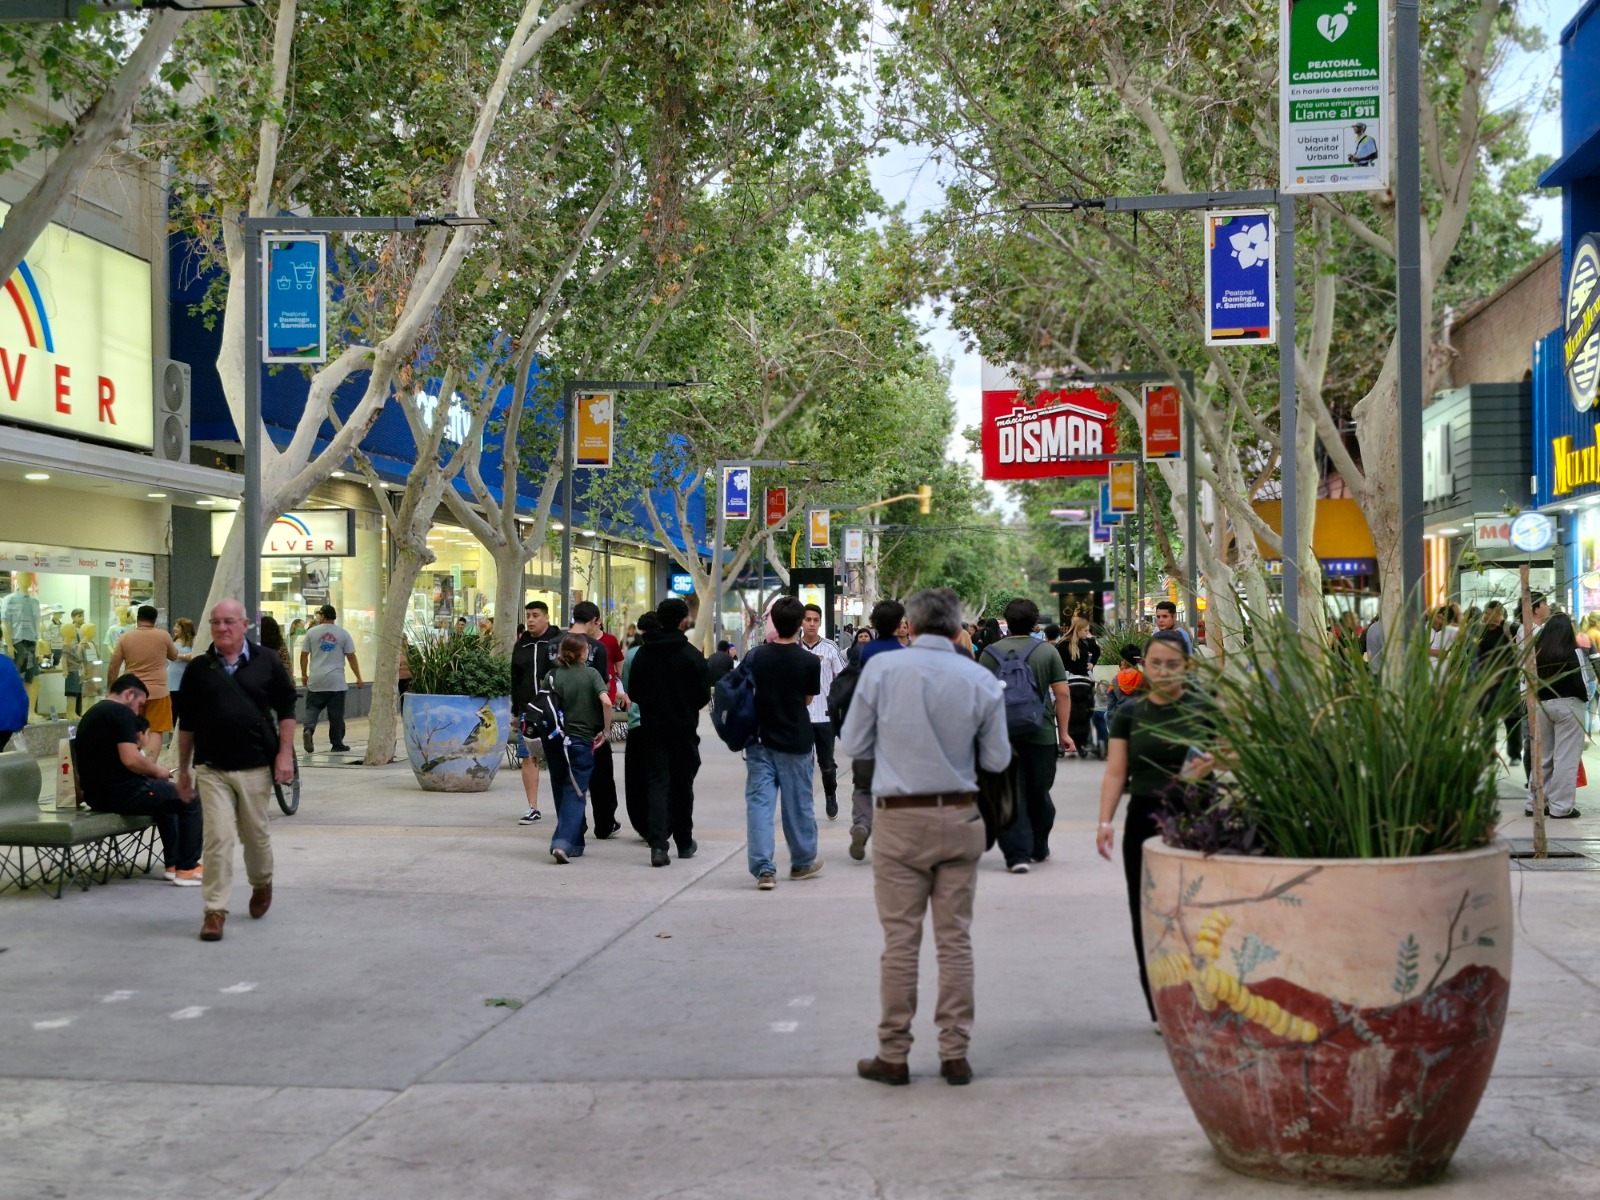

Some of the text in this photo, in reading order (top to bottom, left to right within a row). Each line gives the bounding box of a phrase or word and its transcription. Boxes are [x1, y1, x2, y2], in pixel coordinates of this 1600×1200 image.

[1308, 59, 1361, 69] PEATONAL
[1292, 69, 1377, 80] CARDIOASISTIDA
[1291, 88, 1301, 96] En
[1303, 87, 1330, 95] horario
[1343, 84, 1379, 92] comercio
[1330, 99, 1375, 107] emergencia
[1295, 106, 1375, 121] Llame al 911
[1298, 136, 1329, 145] Ubique
[1305, 144, 1338, 152] Monitor
[1307, 153, 1339, 161] Urbano
[1552, 422, 1600, 495] MULTI
